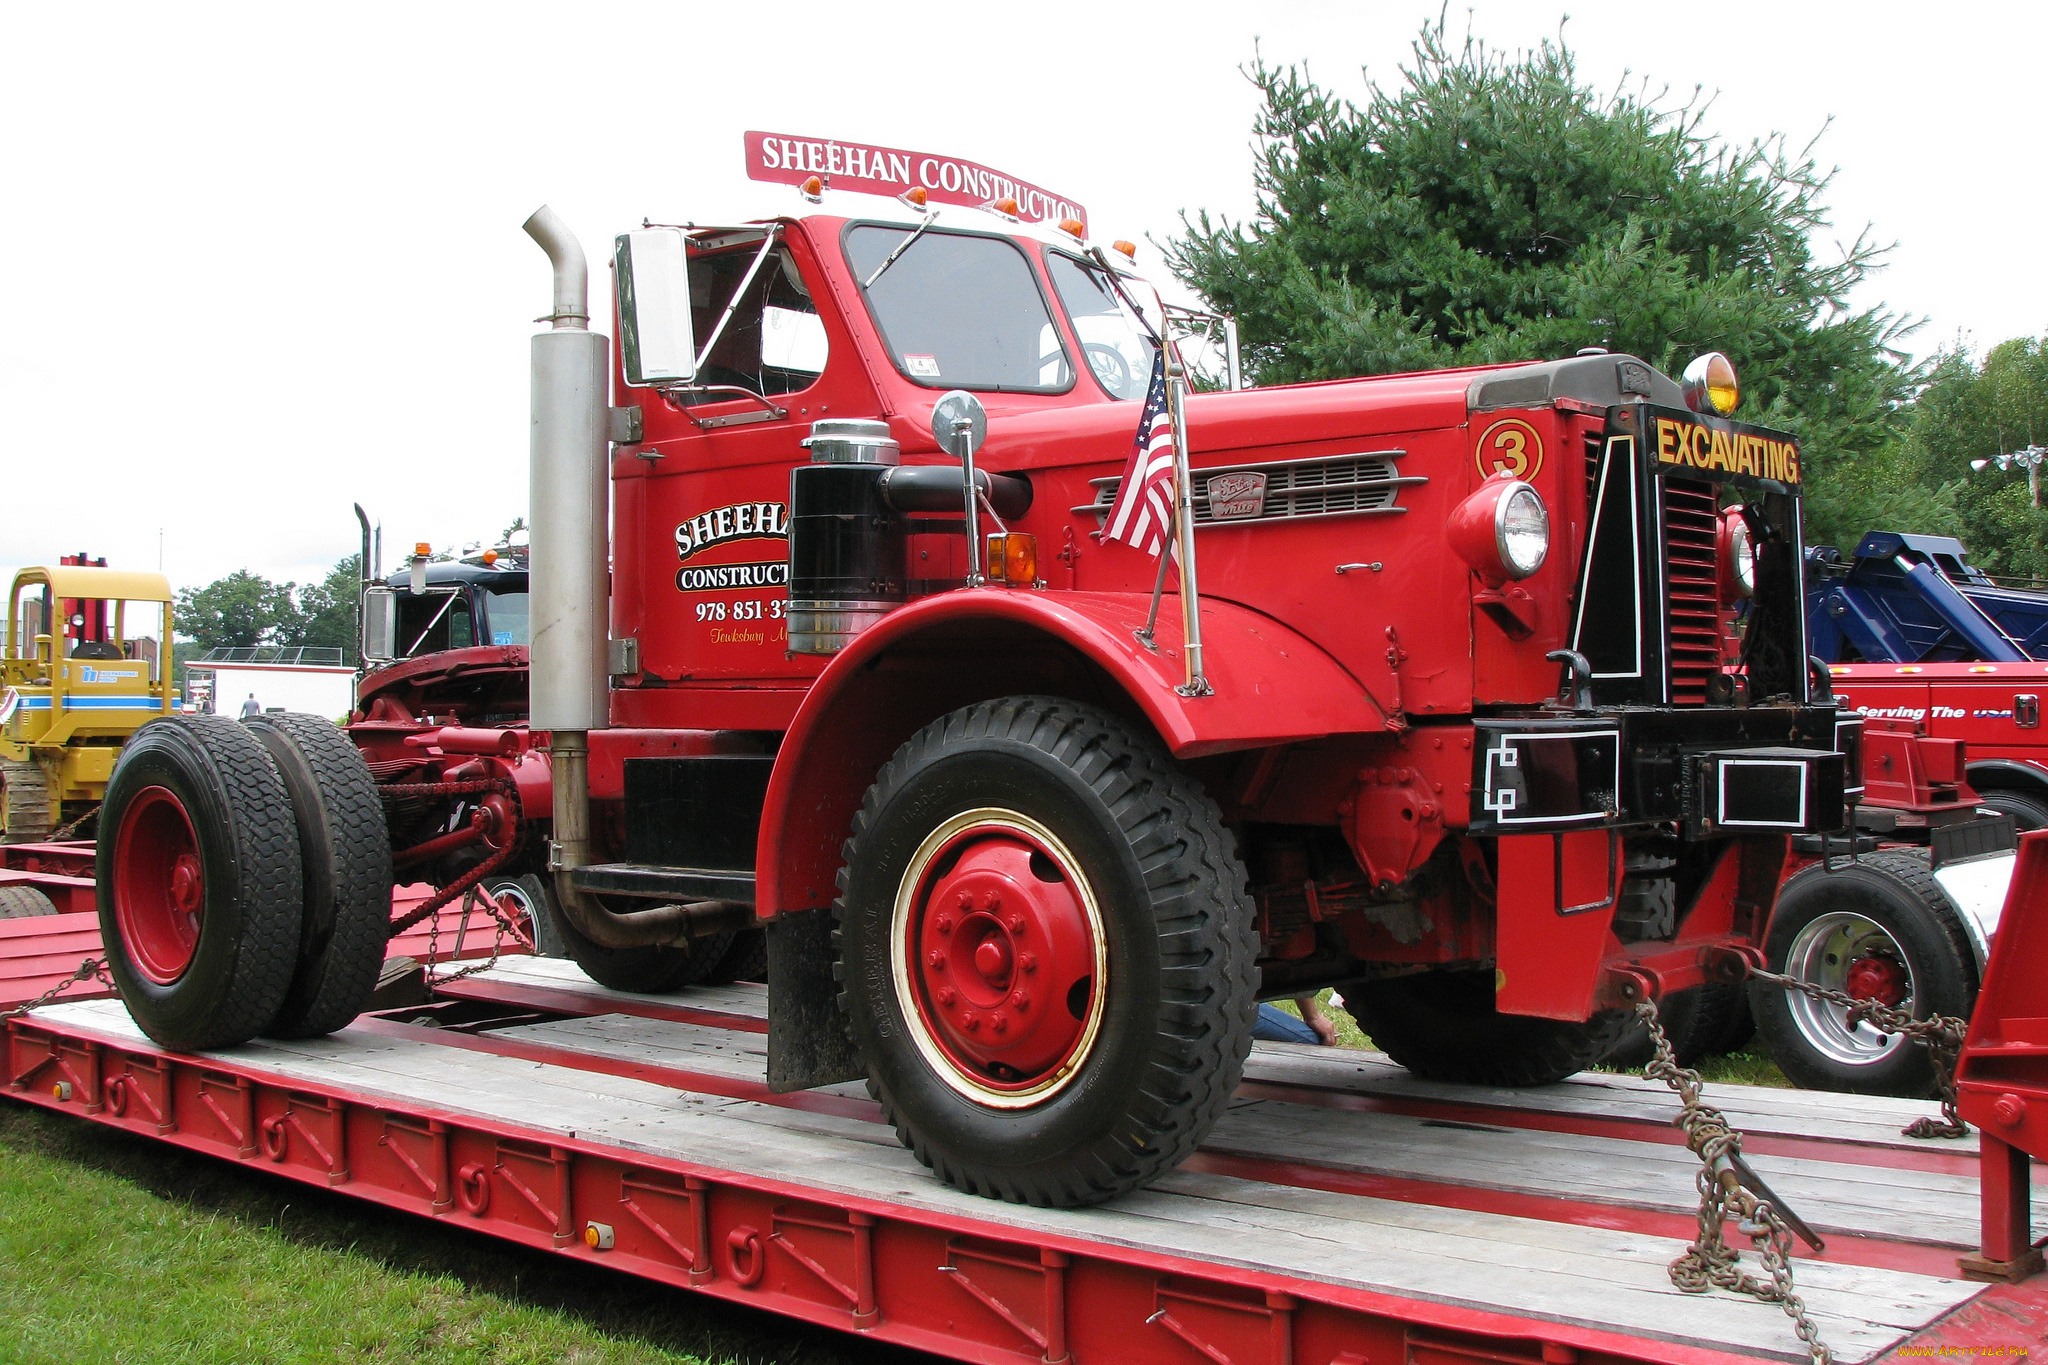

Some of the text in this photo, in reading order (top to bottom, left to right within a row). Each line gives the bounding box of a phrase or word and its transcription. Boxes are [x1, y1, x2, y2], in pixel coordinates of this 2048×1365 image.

[761, 136, 1081, 223] SHEEHAN CONSTRUCTION
[1493, 430, 1528, 476] 3
[1656, 418, 1798, 484] EXCAVATING
[1856, 706, 1926, 720] Serving
[1931, 706, 1965, 718] The
